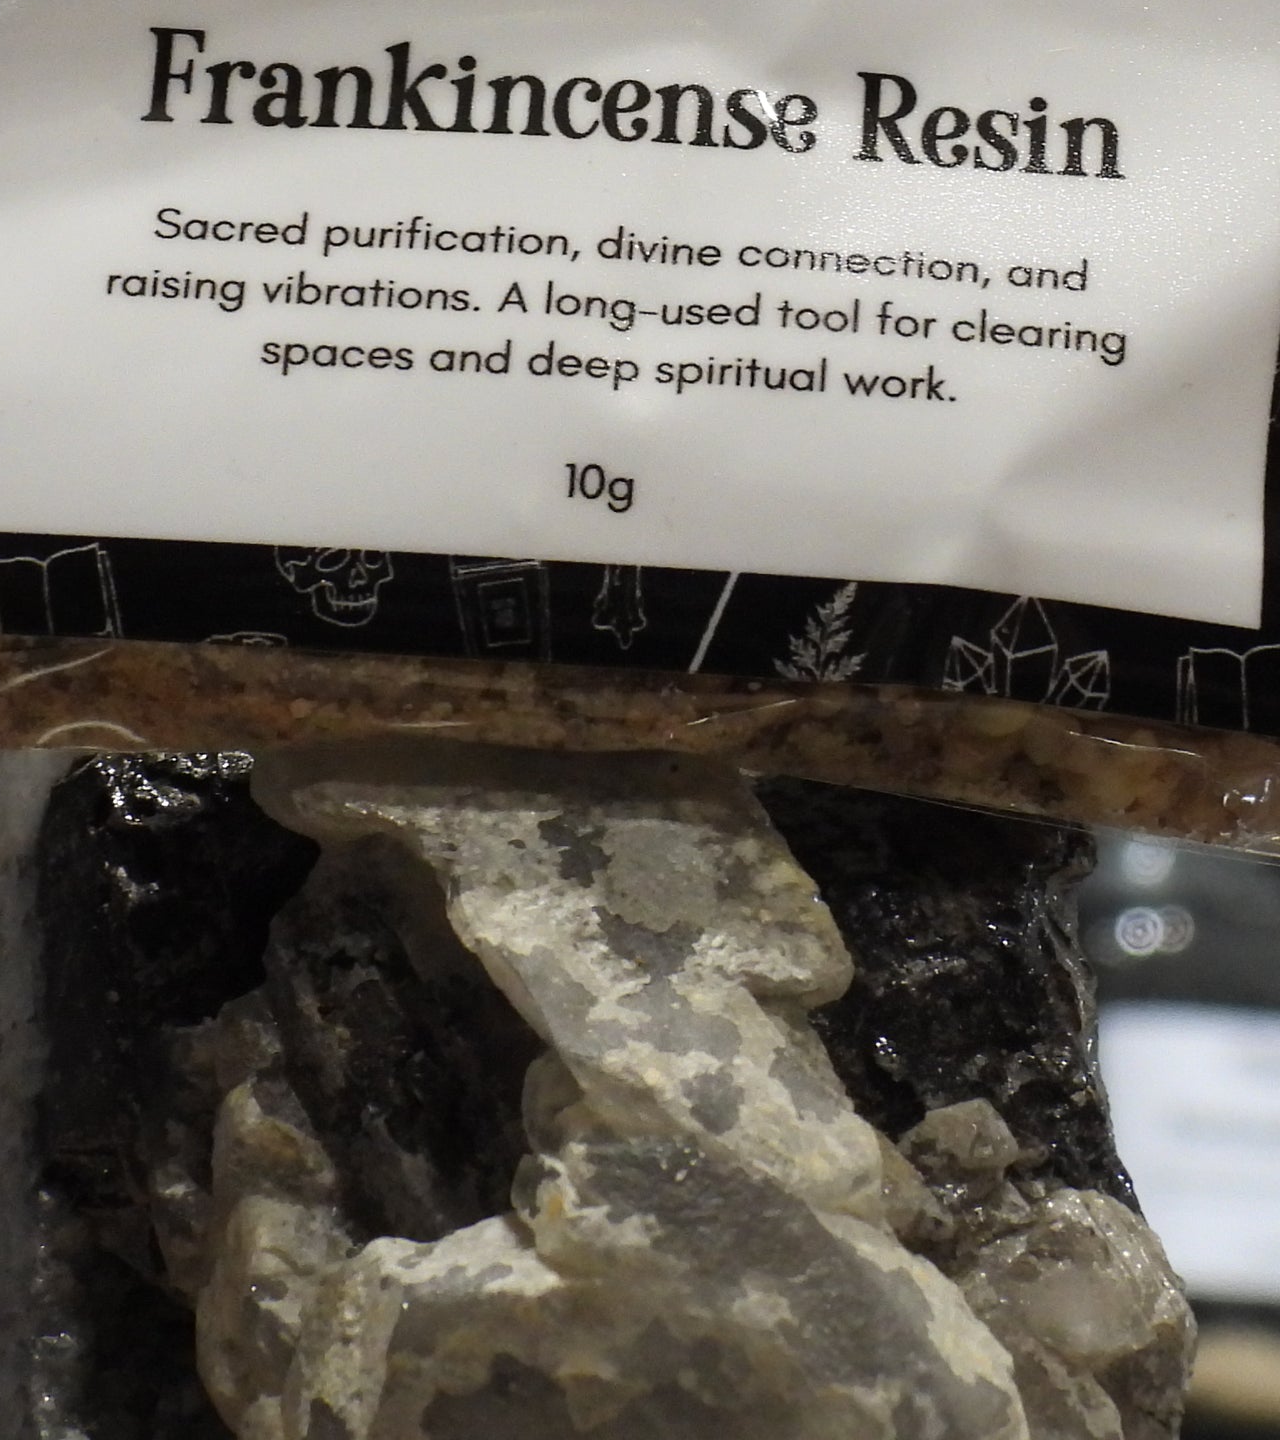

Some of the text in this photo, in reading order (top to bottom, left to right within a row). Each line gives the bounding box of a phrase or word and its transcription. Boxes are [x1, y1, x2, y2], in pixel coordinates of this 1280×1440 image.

[139, 26, 1127, 181] Frankincense Resin
[153, 207, 1090, 292] Sacred purification, divine connection, and
[106, 266, 1128, 367] raising vibrations. A long-used tool for clearing
[260, 338, 958, 403] spaces and deep spiritual work.
[564, 462, 636, 514] 10g
